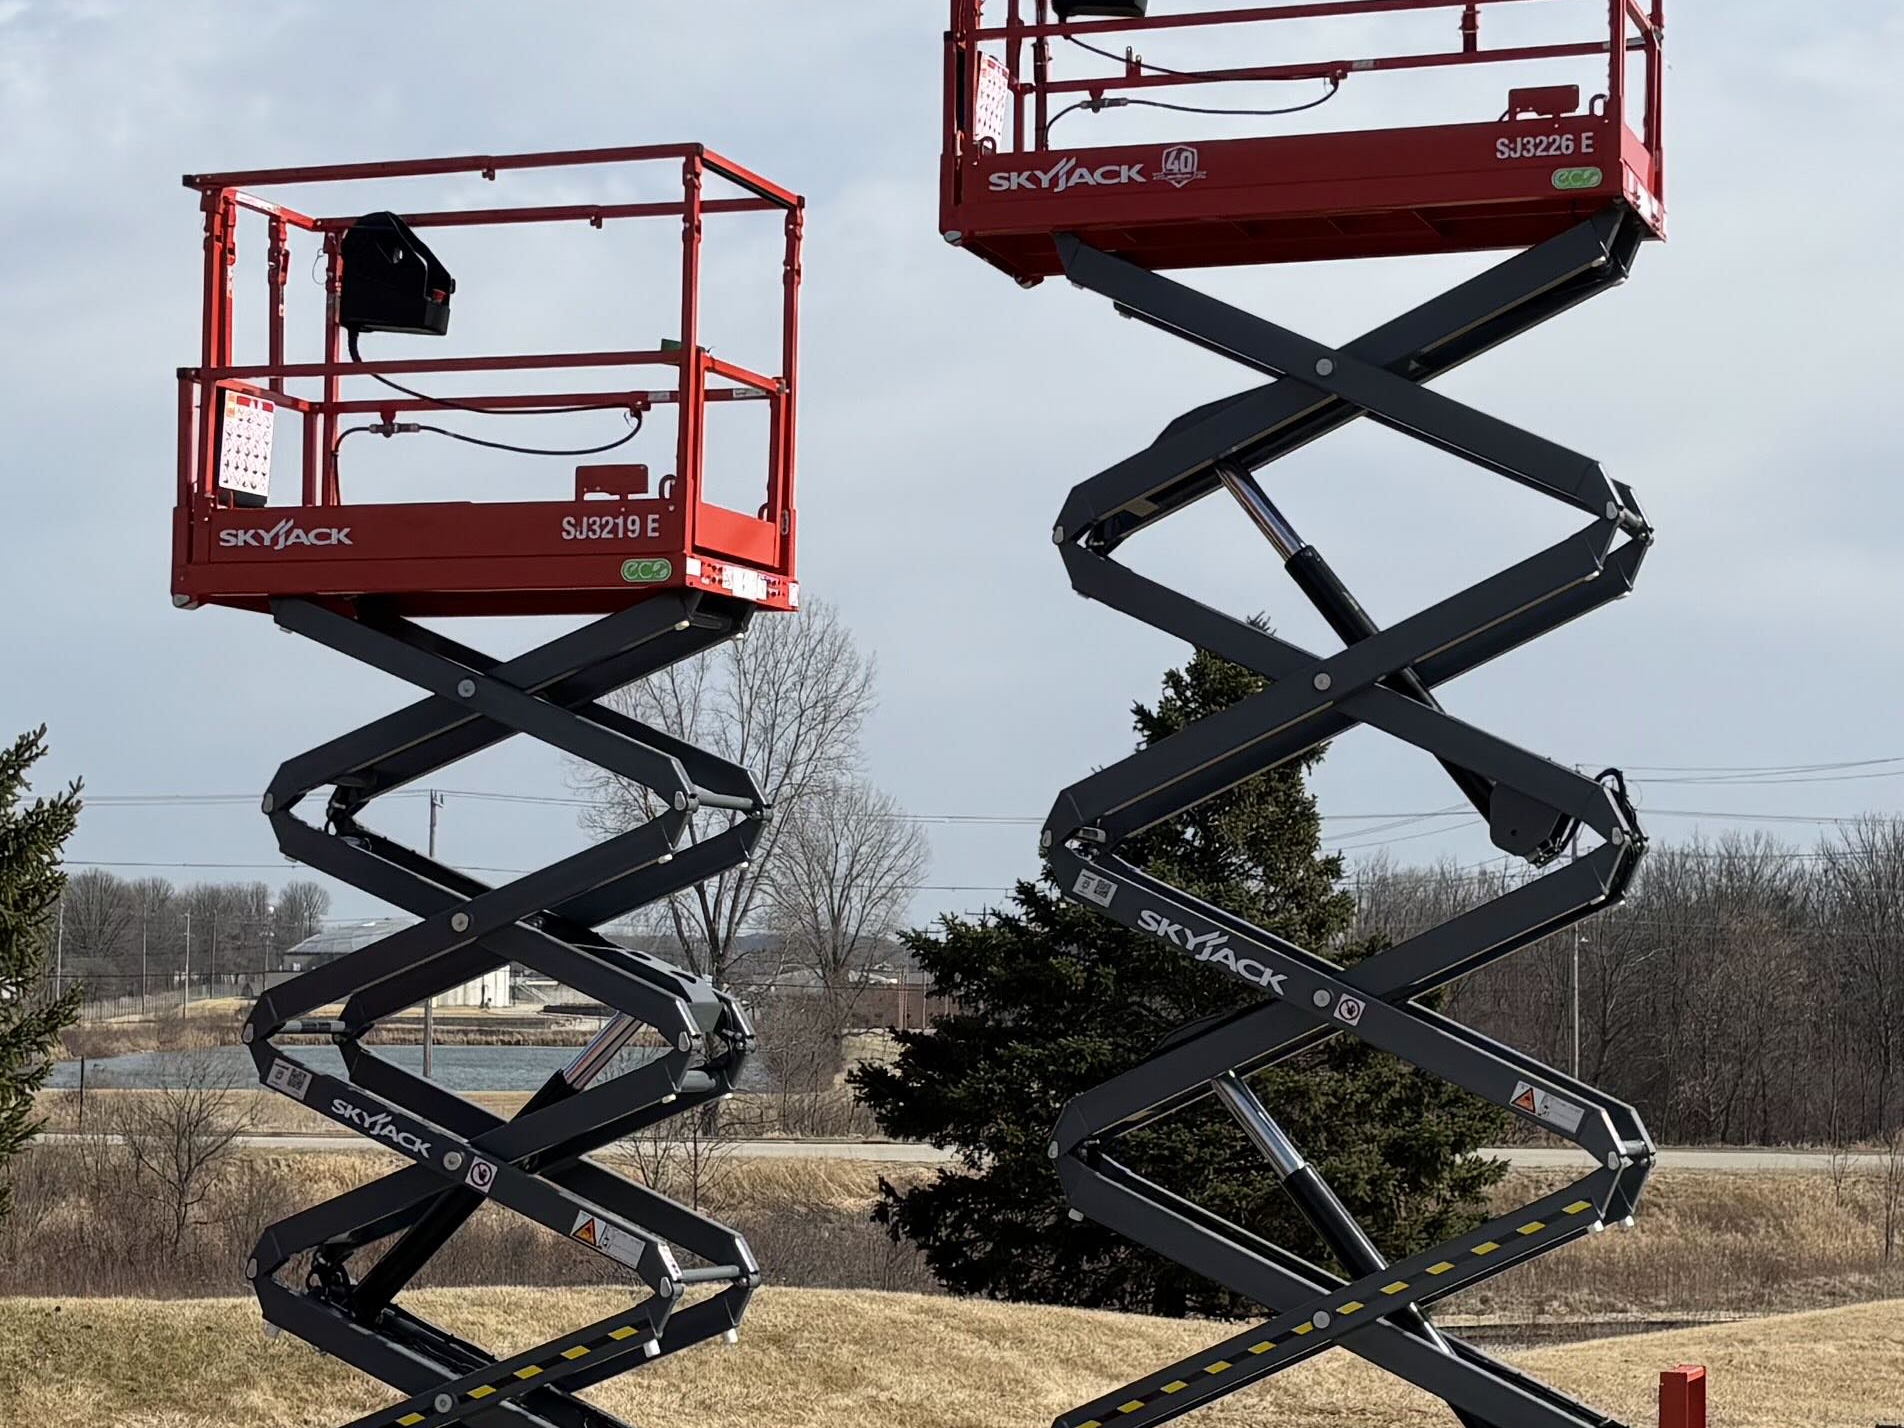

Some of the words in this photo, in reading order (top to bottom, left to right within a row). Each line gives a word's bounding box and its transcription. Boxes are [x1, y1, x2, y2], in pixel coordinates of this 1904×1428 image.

[1166, 149, 1194, 173] 40
[1496, 134, 1574, 159] SJ3226
[1581, 132, 1594, 153] E
[988, 157, 1146, 192] SKYJACK
[219, 518, 353, 550] SKYJACK
[561, 515, 641, 540] SJ3219
[647, 514, 660, 537] E
[1137, 910, 1288, 996] SKYJACK
[331, 1098, 432, 1159] SKYJACK
